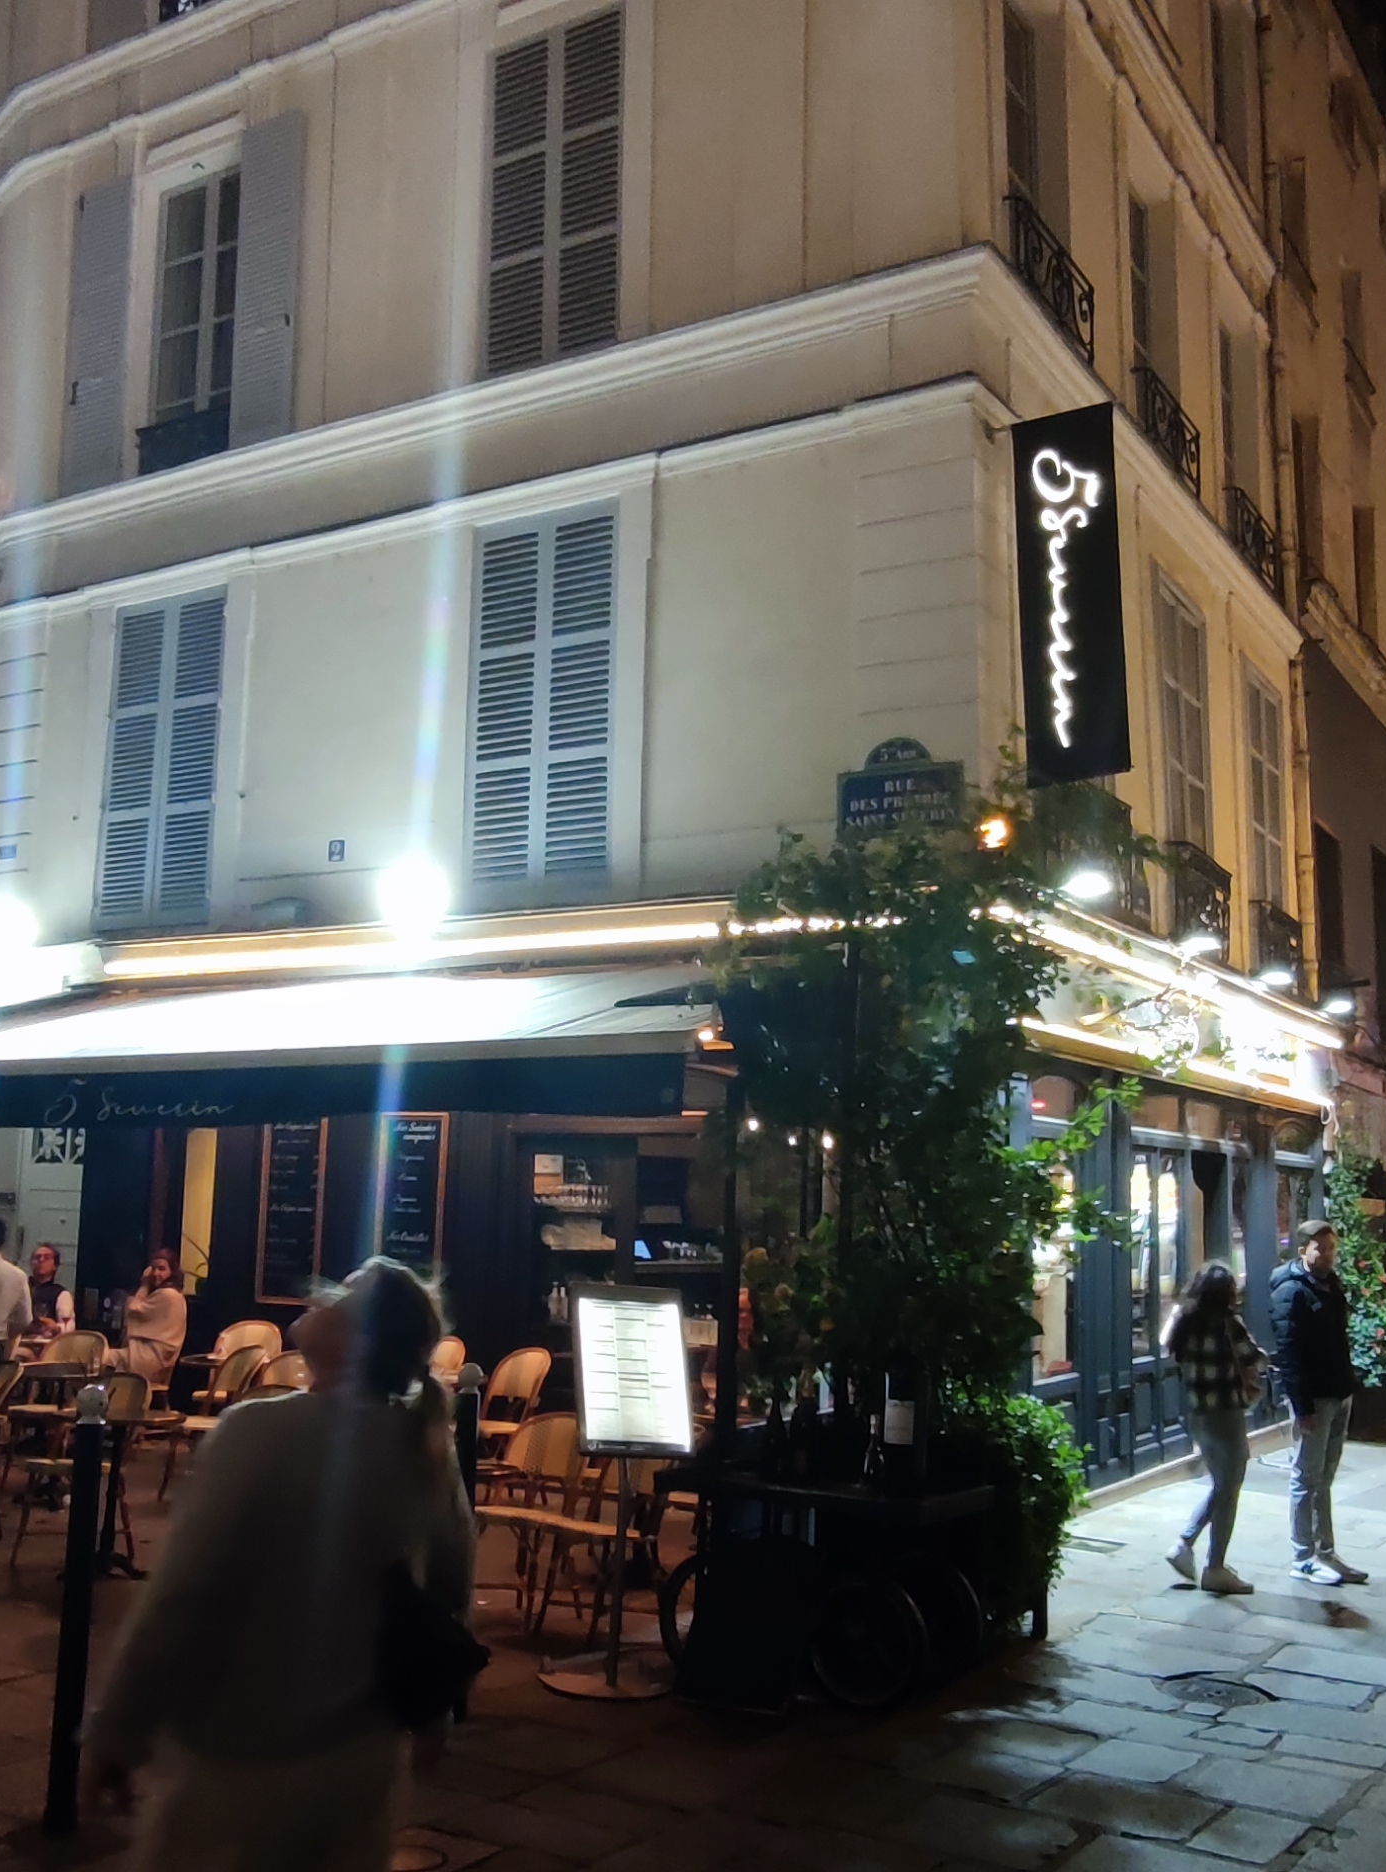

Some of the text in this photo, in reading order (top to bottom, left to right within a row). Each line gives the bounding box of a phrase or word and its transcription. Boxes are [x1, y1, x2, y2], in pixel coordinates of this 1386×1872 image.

[884, 778, 916, 793] RUE
[849, 791, 953, 812] DES PRTRES
[330, 841, 342, 861] 2
